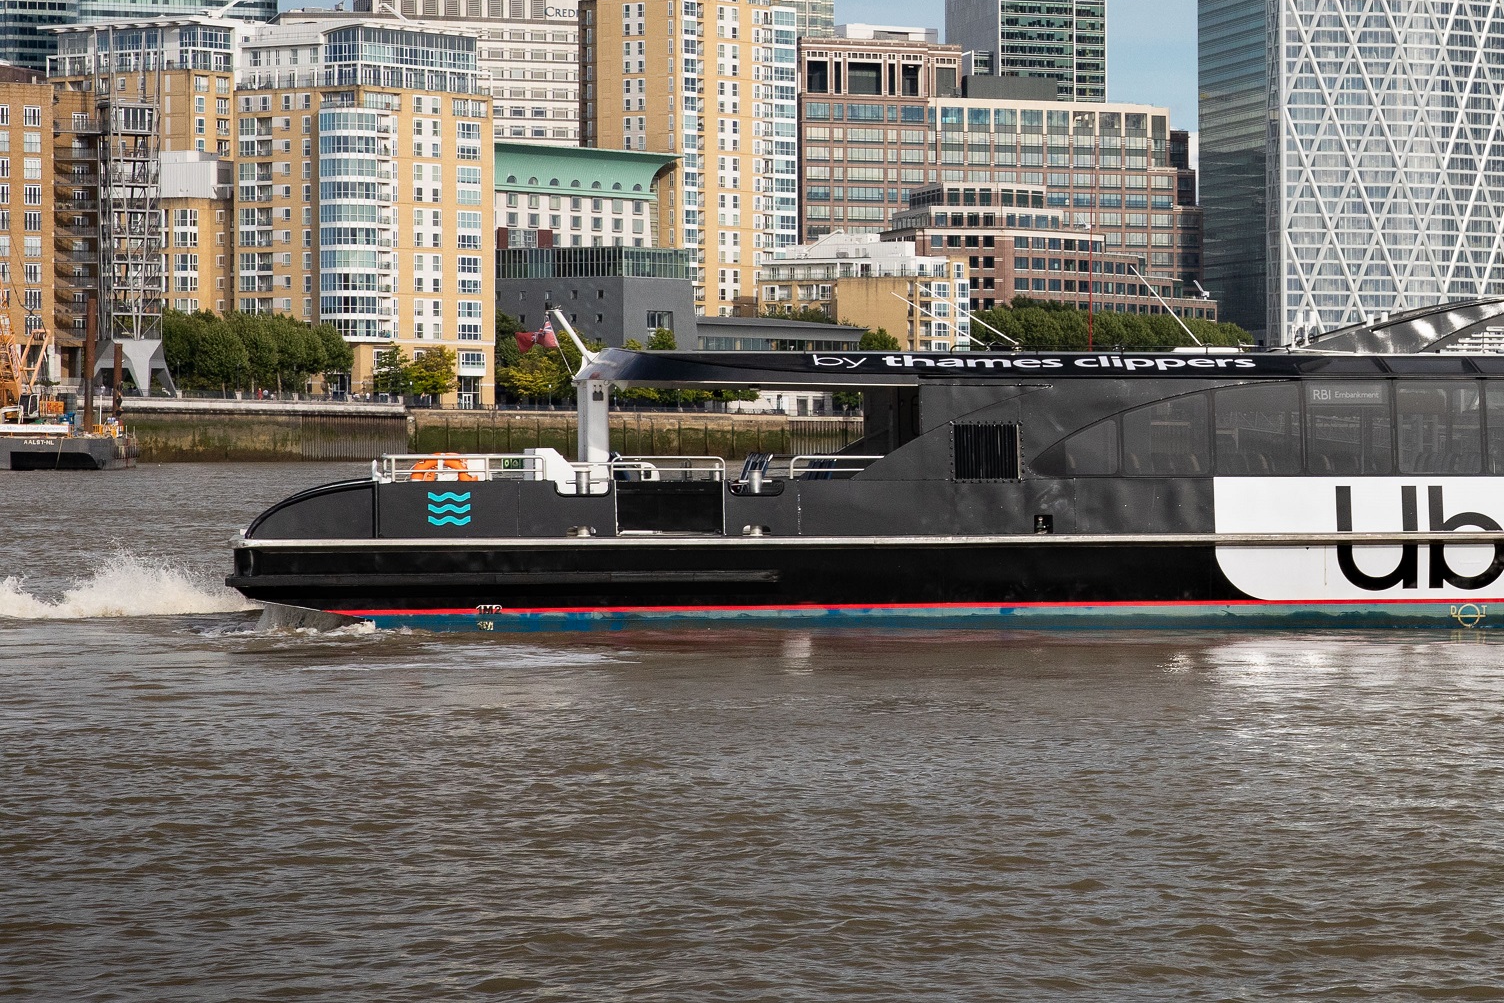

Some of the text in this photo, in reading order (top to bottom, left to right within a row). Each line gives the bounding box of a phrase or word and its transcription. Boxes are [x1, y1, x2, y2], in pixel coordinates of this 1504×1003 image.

[812, 354, 1257, 371] by thames clippers
